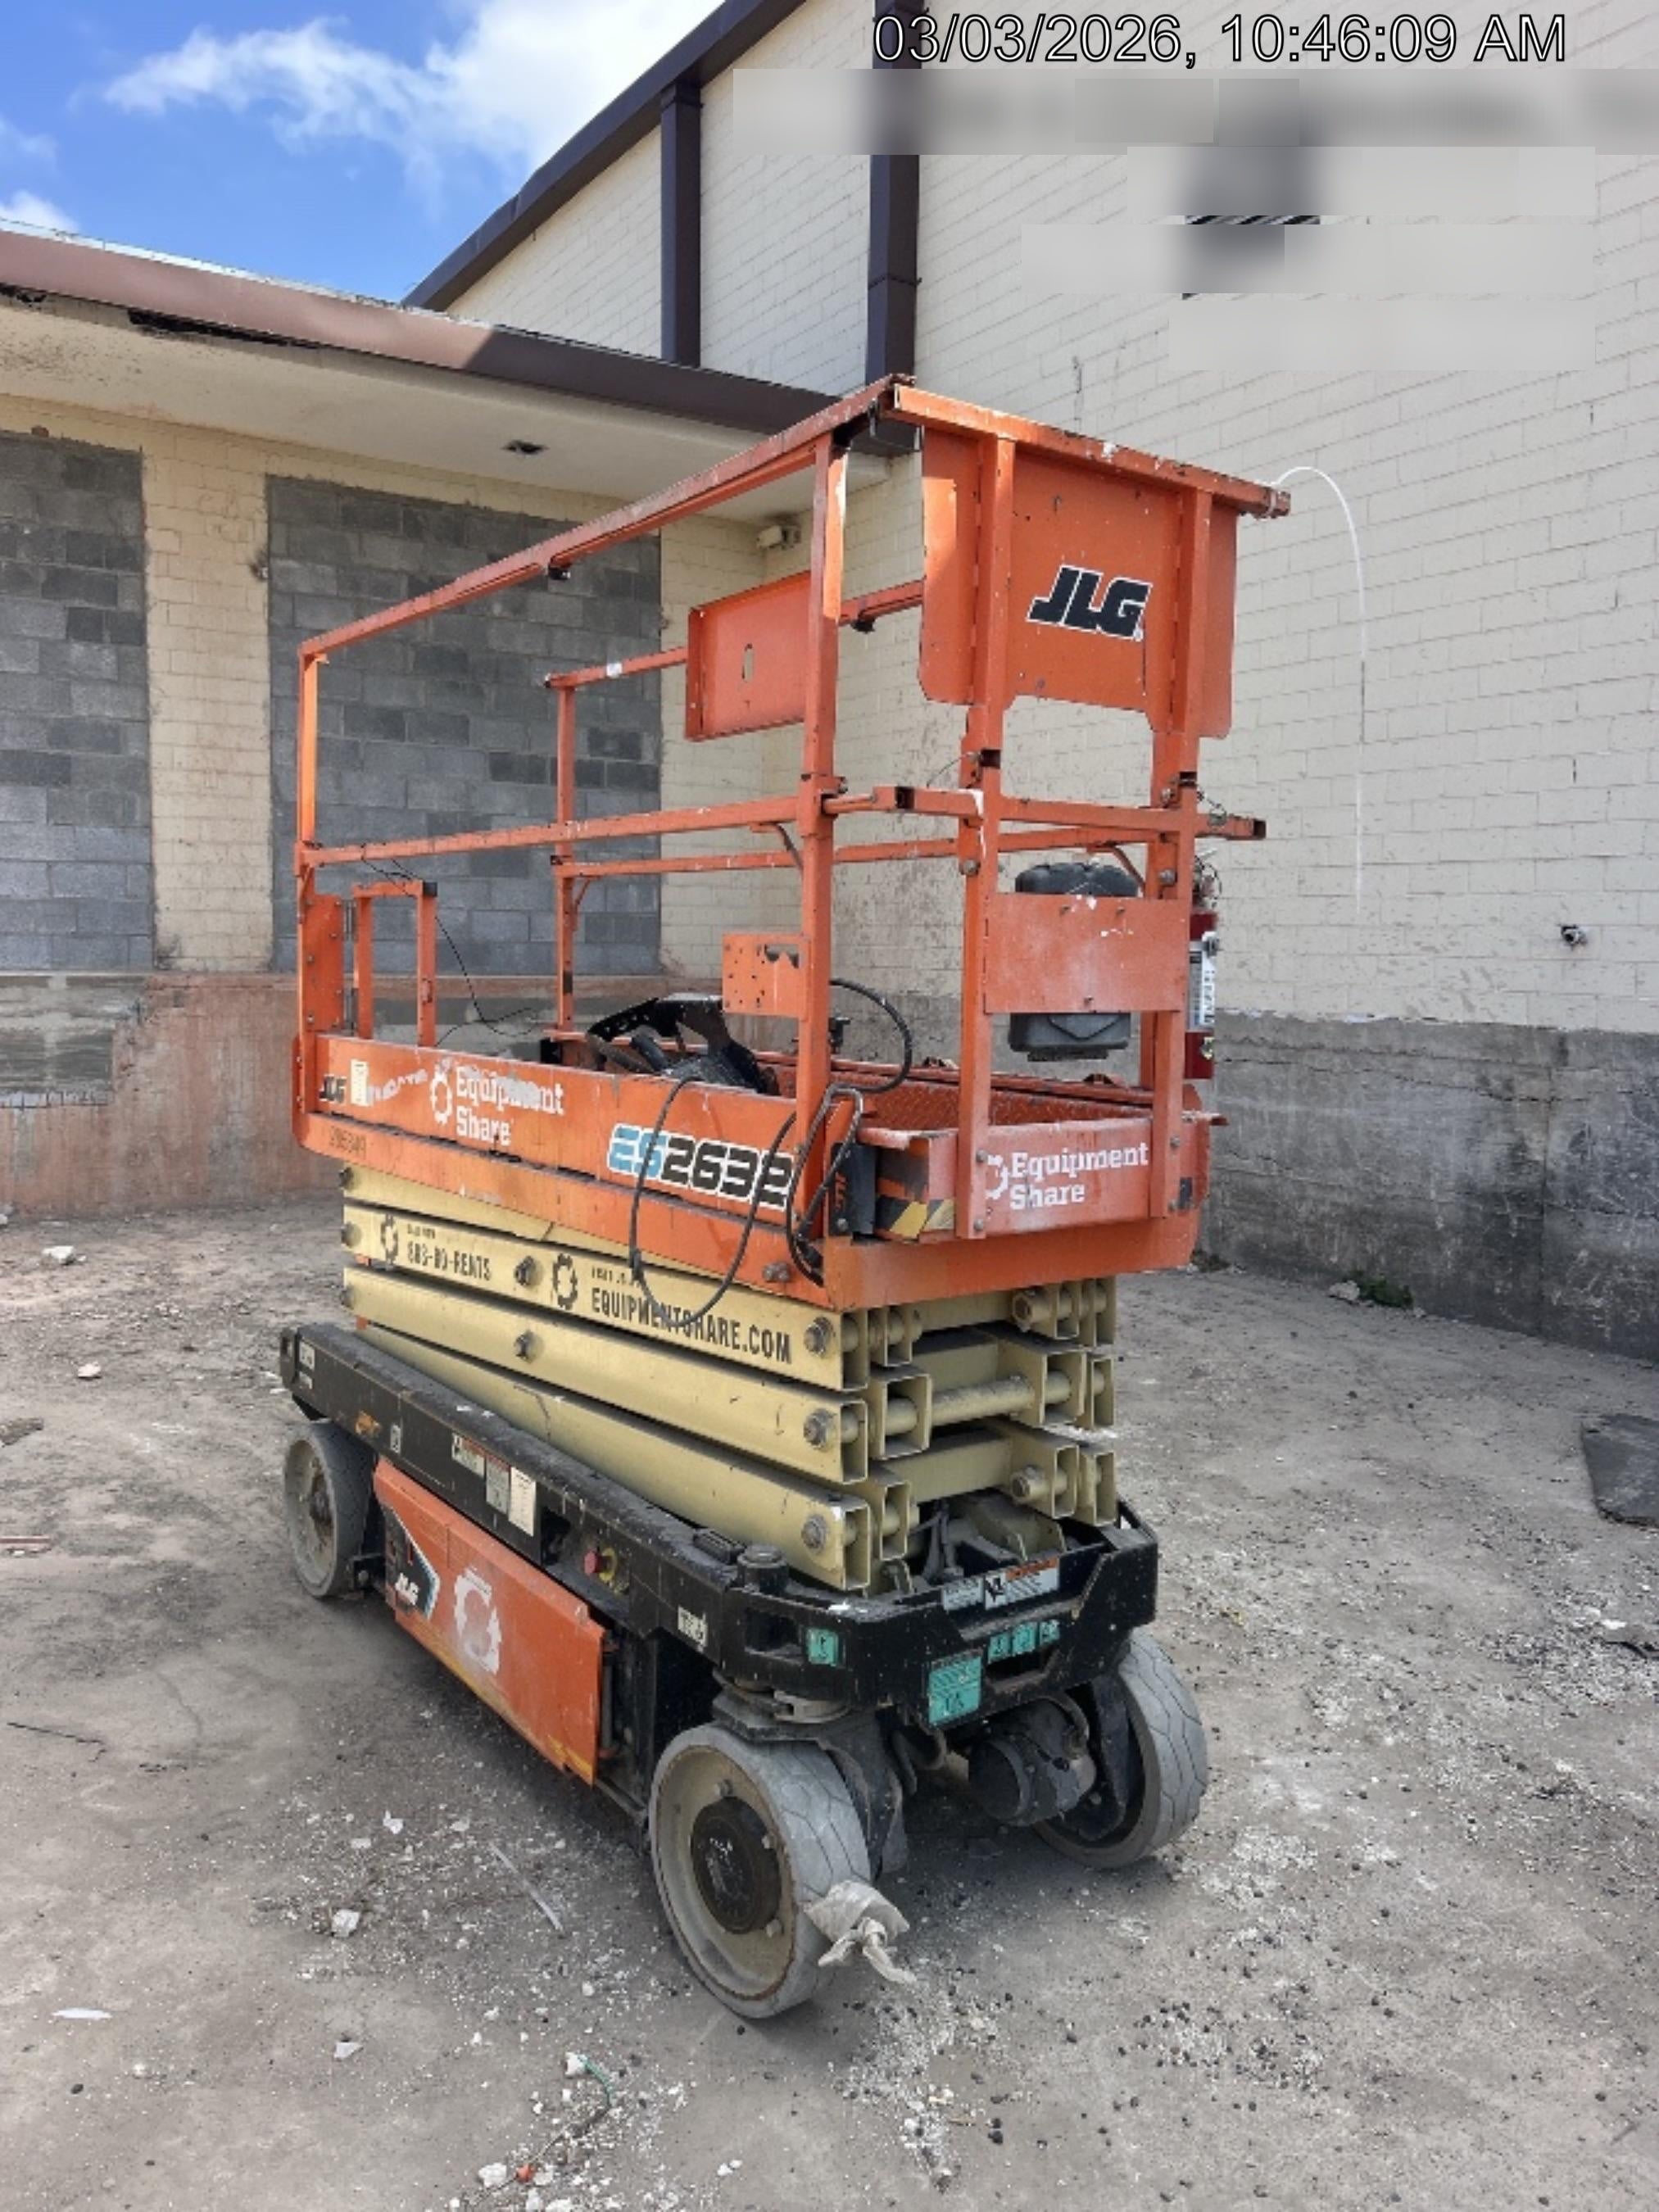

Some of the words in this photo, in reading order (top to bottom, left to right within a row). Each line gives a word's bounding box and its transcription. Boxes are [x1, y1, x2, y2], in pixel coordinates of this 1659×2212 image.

[1026, 564, 1154, 641] JLG
[456, 1063, 564, 1116] Equipment
[456, 1105, 511, 1146] Share
[1011, 1142, 1149, 1182] Equipment
[1009, 1184, 1086, 1211] Share
[591, 1287, 792, 1364] EQUIPMENTSHARE.COM
